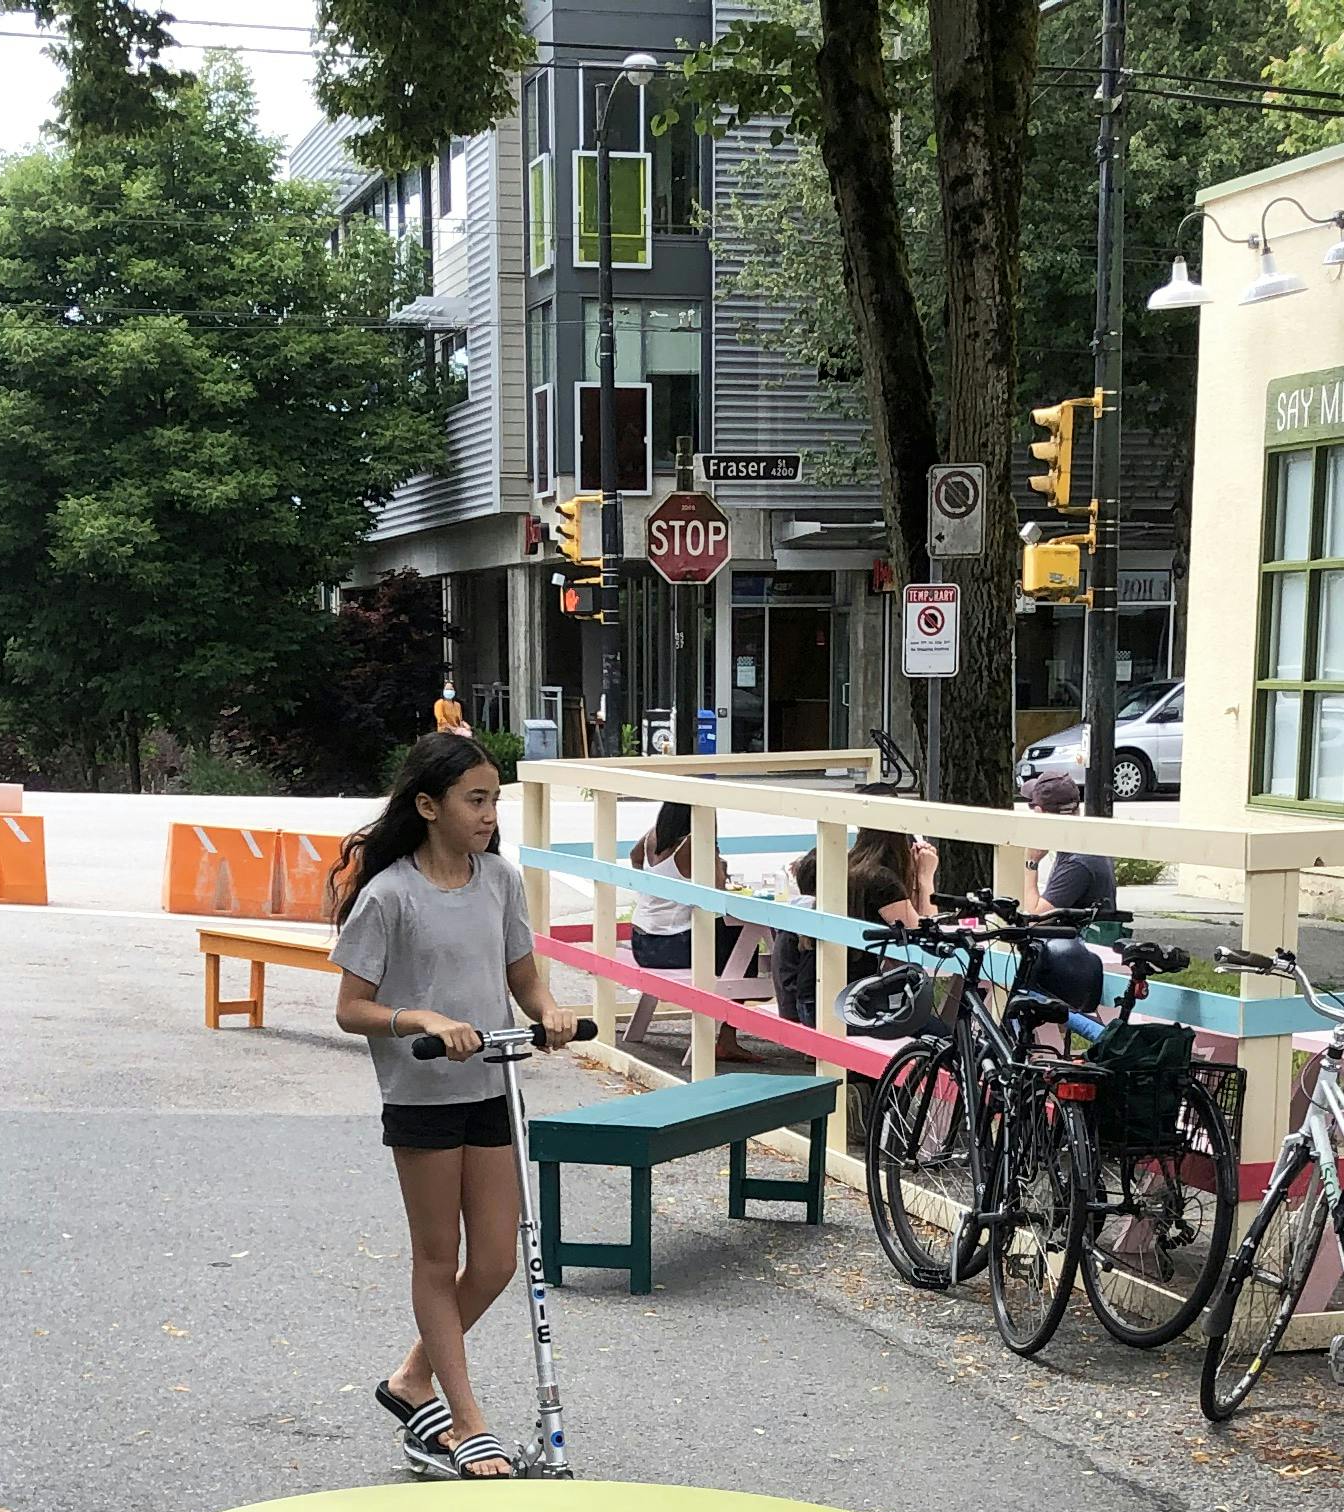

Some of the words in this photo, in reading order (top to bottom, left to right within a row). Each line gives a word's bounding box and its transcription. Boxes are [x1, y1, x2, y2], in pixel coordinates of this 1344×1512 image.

[1276, 386, 1314, 432] SAY
[709, 459, 766, 477] Fraser
[771, 467, 794, 477] 4200
[650, 520, 727, 557] STOP
[529, 1257, 552, 1344] micro
